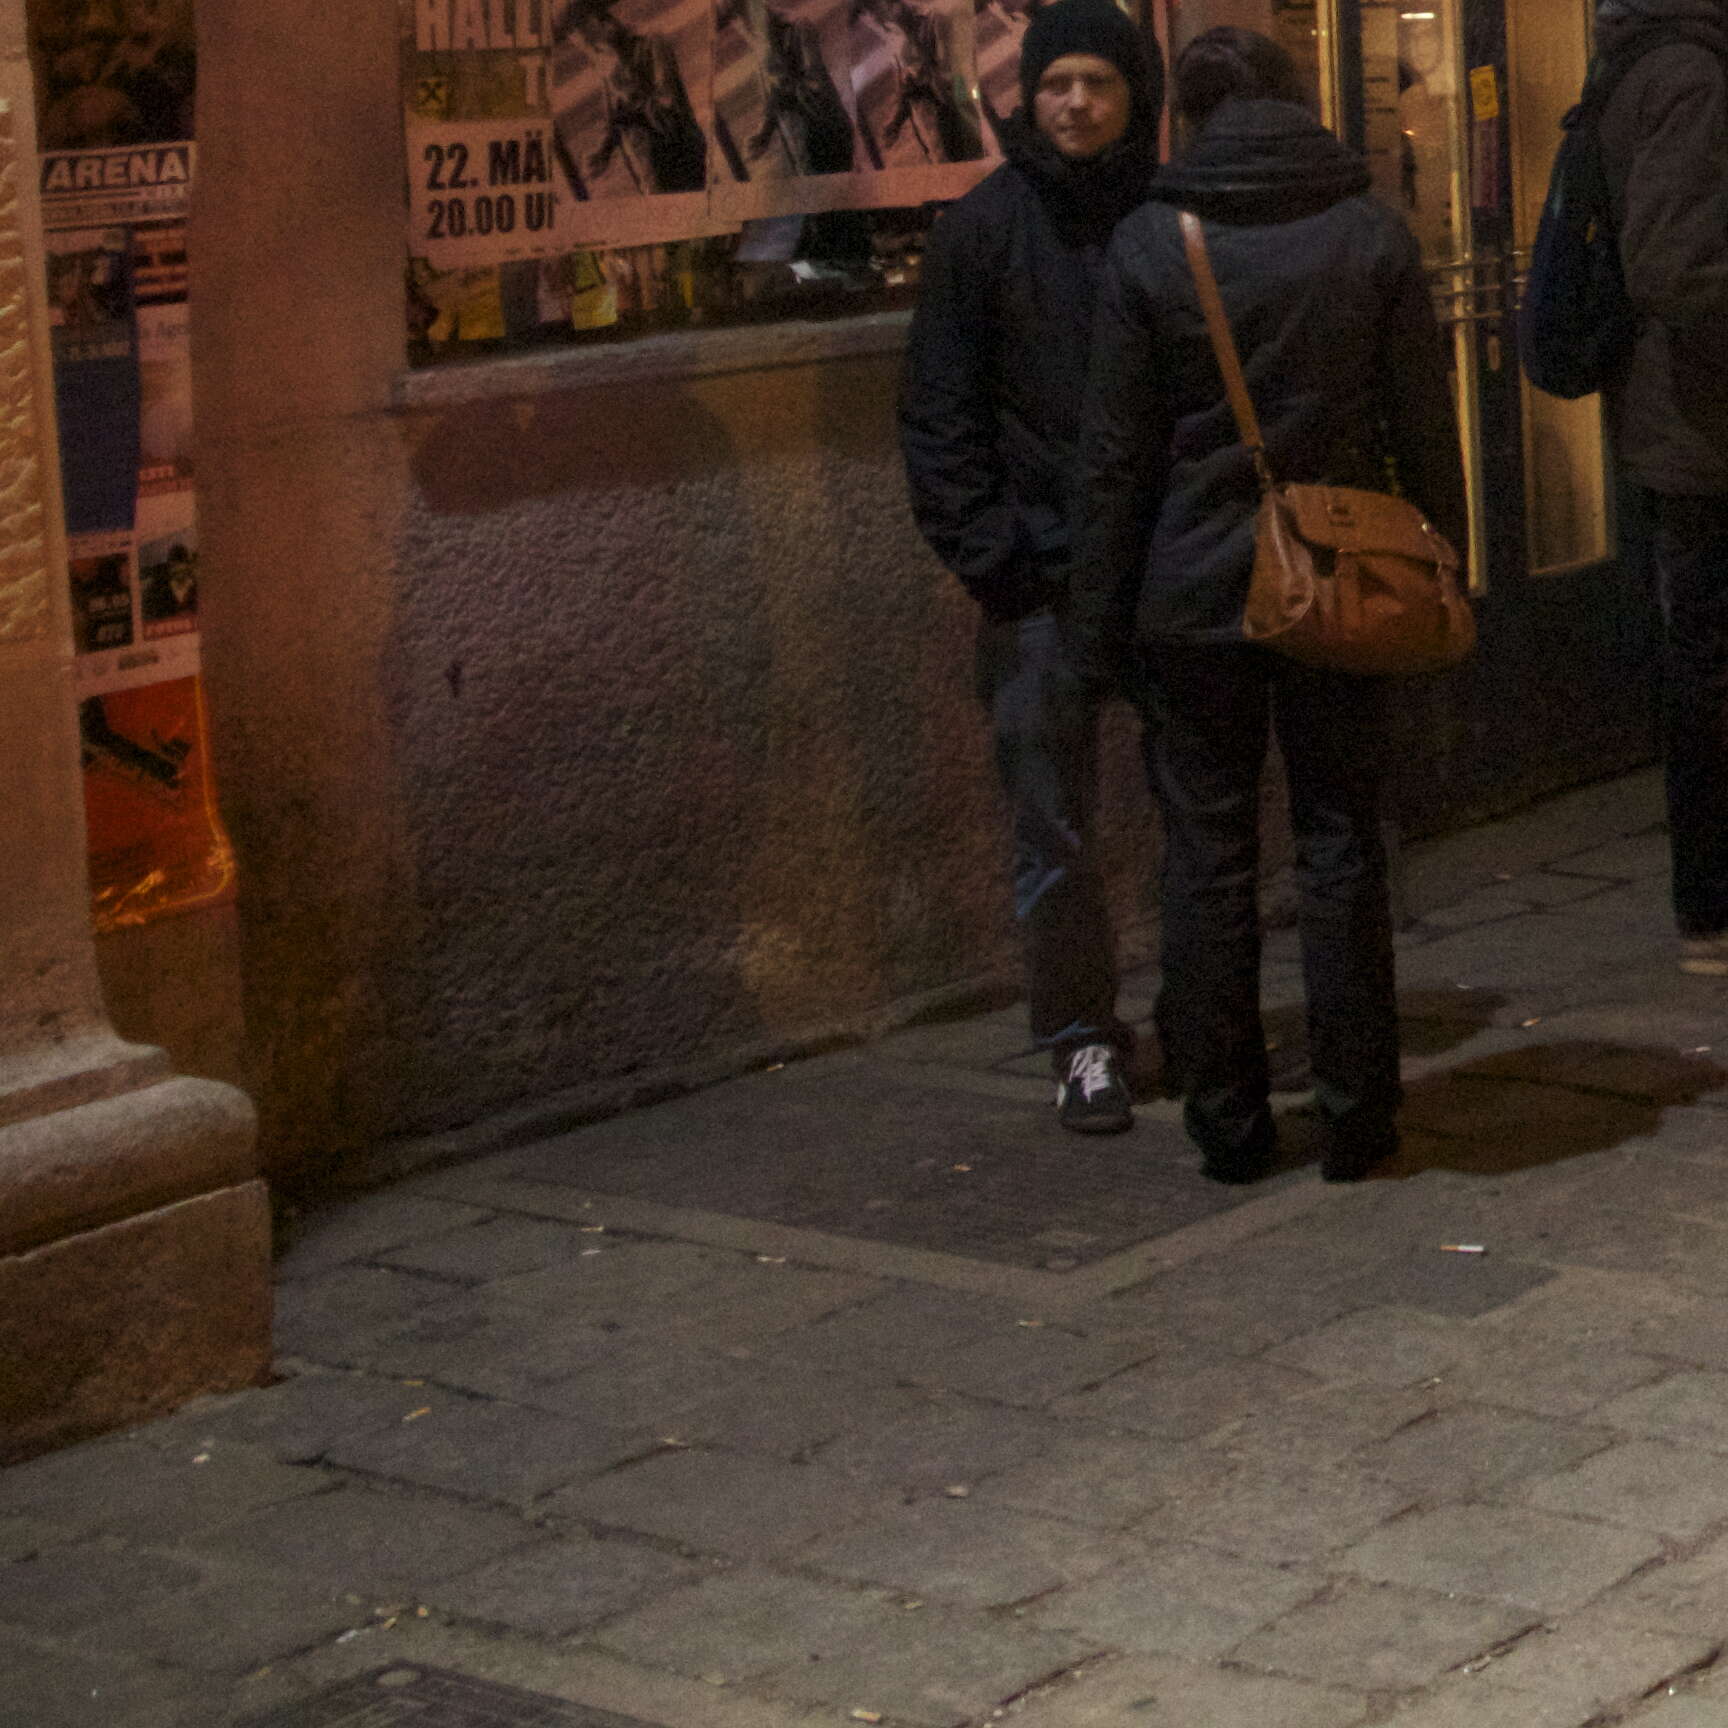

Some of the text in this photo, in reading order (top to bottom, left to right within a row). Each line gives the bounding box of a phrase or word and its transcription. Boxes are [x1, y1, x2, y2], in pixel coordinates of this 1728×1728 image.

[45, 149, 186, 190] ARENA
[424, 129, 554, 191] 22. MÄ
[426, 194, 516, 240] 20.00
